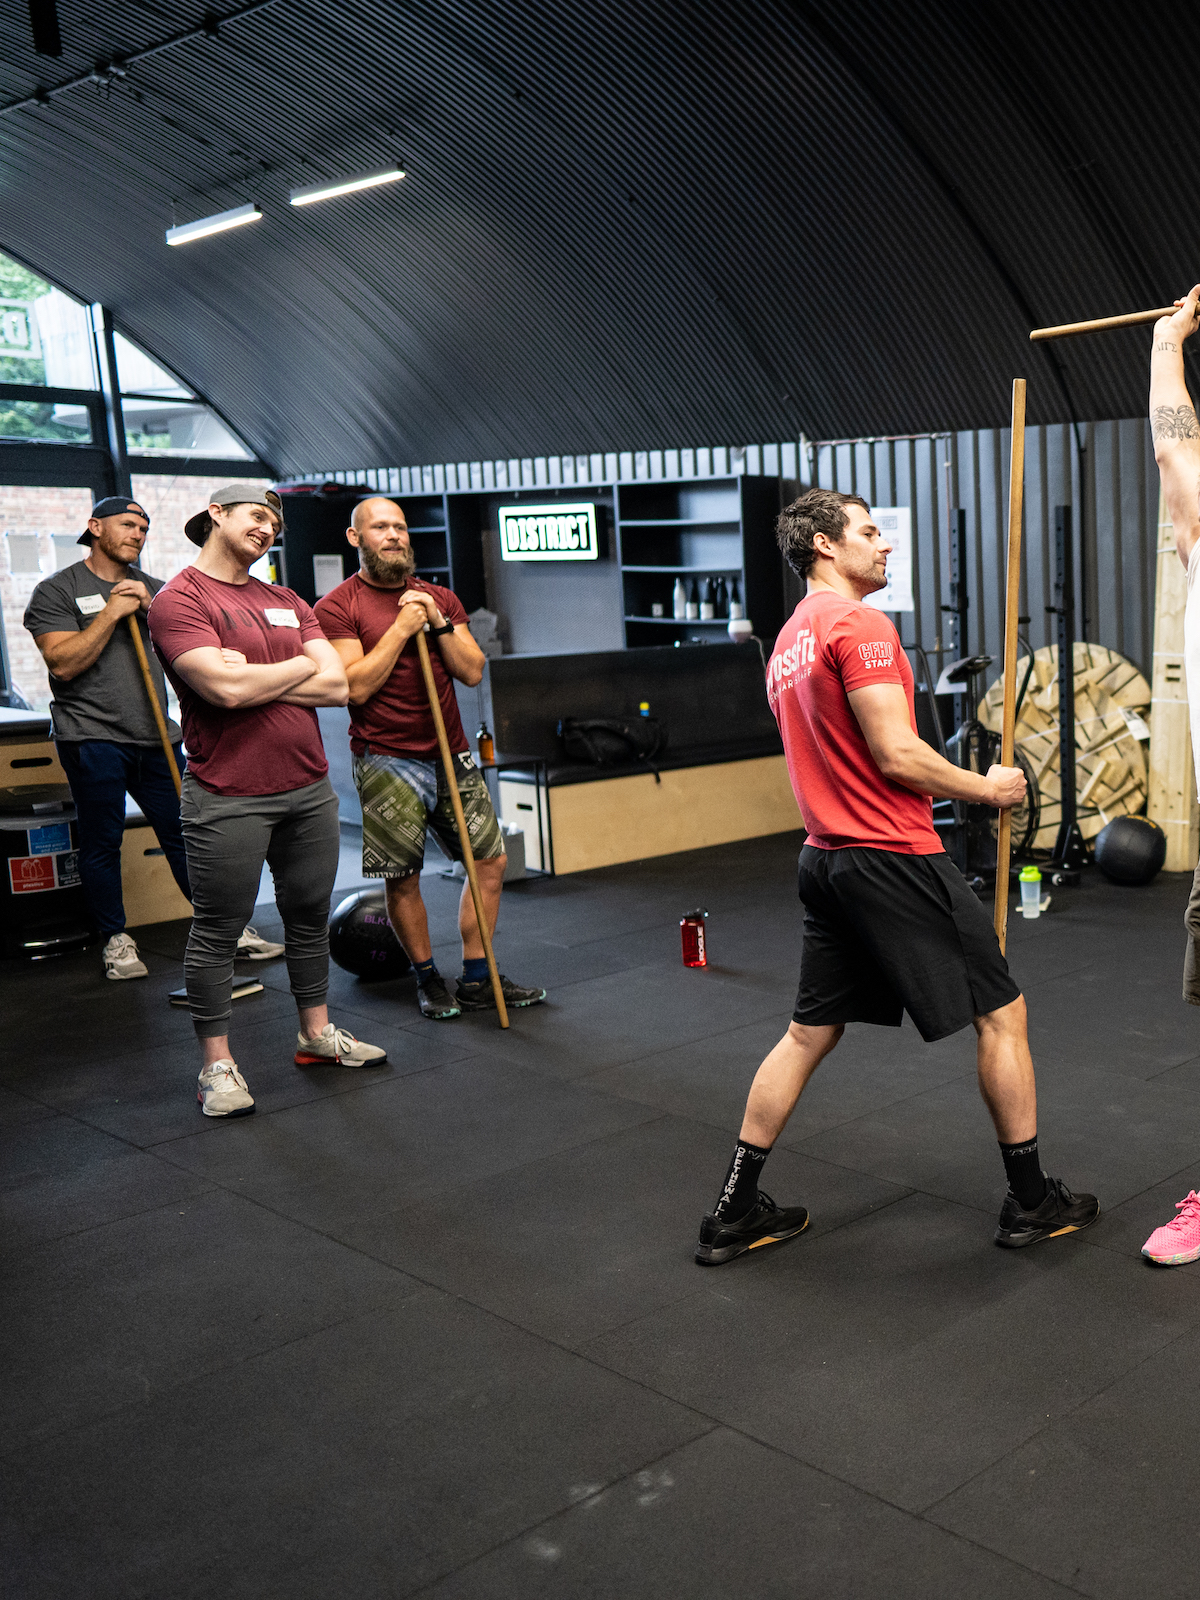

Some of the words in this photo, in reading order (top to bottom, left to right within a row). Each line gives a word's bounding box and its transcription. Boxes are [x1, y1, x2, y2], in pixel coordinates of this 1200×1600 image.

[506, 515, 589, 551] DISTRICT
[858, 641, 894, 661] CFHQ
[865, 659, 893, 669] STAFF
[364, 914, 385, 926] BLK
[370, 950, 387, 961] 15
